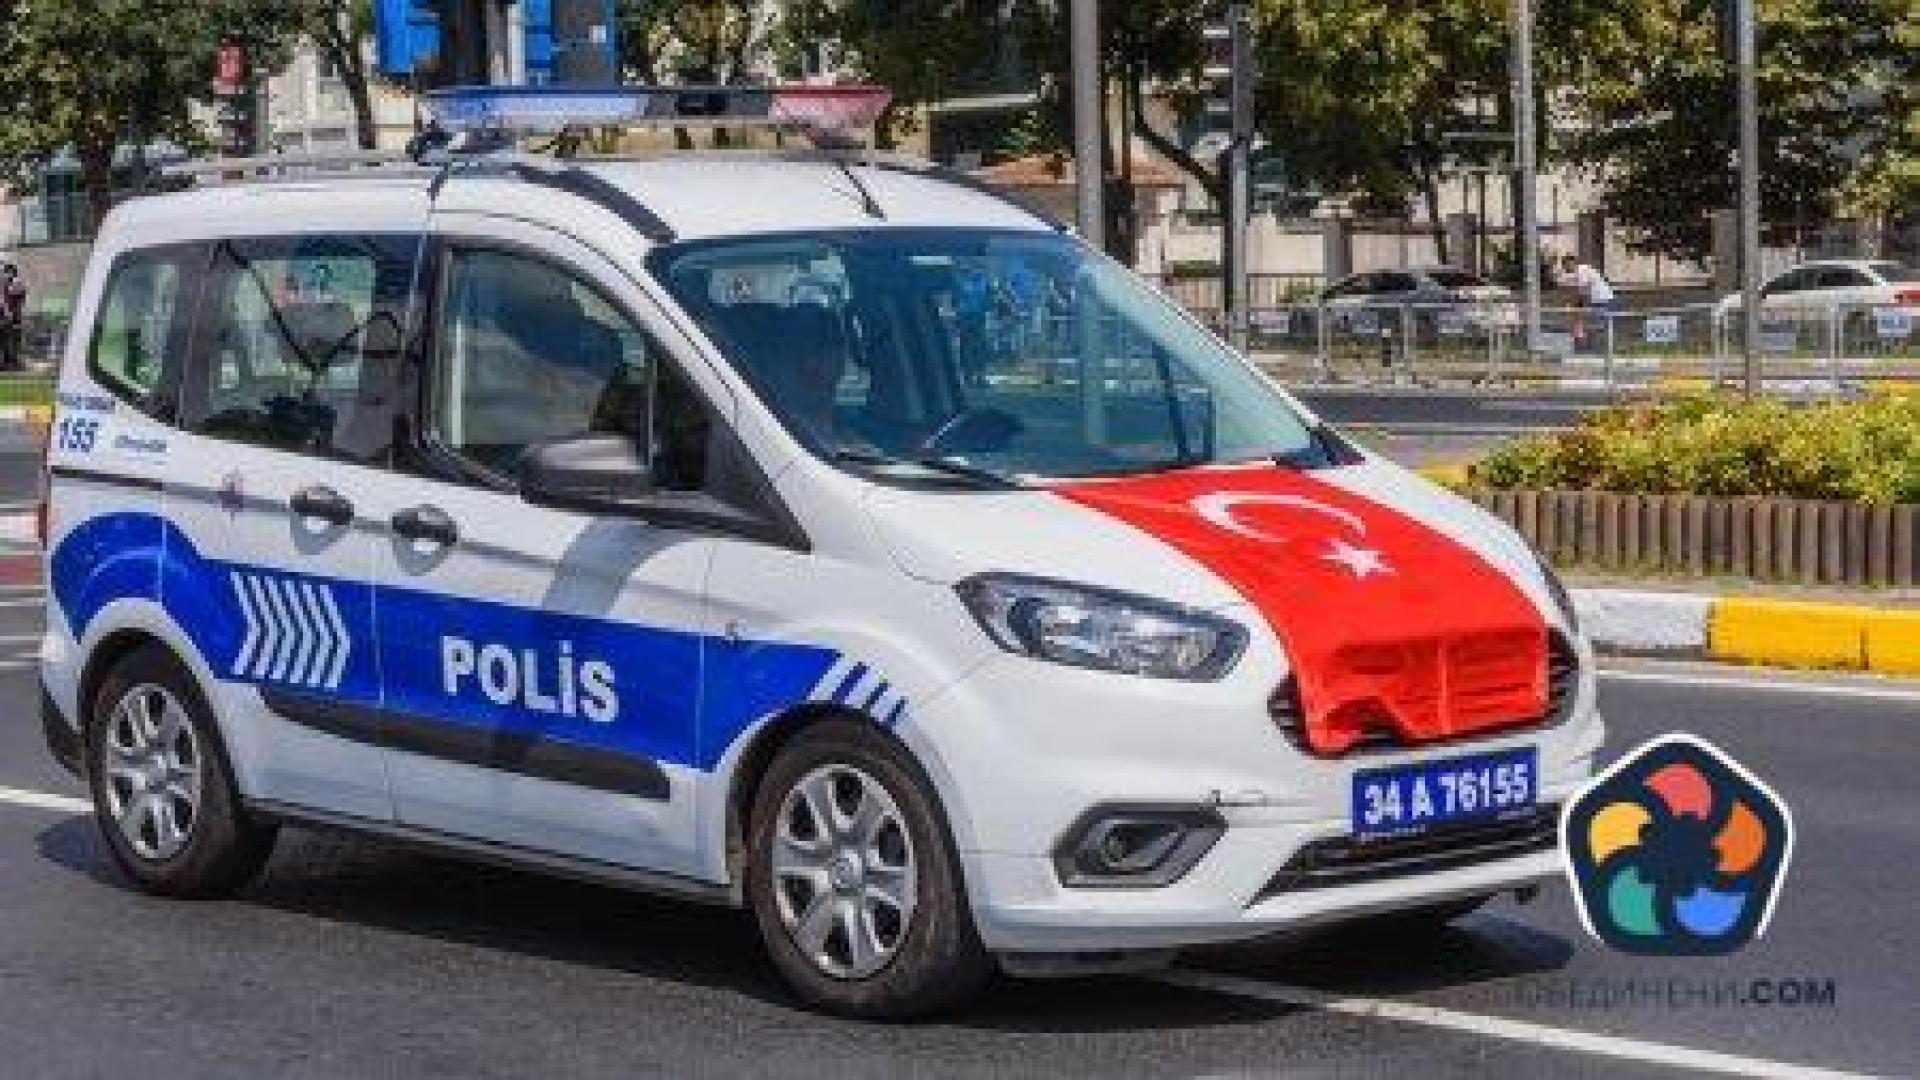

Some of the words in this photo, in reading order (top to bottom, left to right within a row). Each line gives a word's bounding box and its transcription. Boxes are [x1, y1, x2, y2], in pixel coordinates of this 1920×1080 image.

[59, 417, 99, 453] 155
[1364, 780, 1402, 825] 34
[1412, 772, 1435, 821] A
[1437, 763, 1530, 813] 76155
